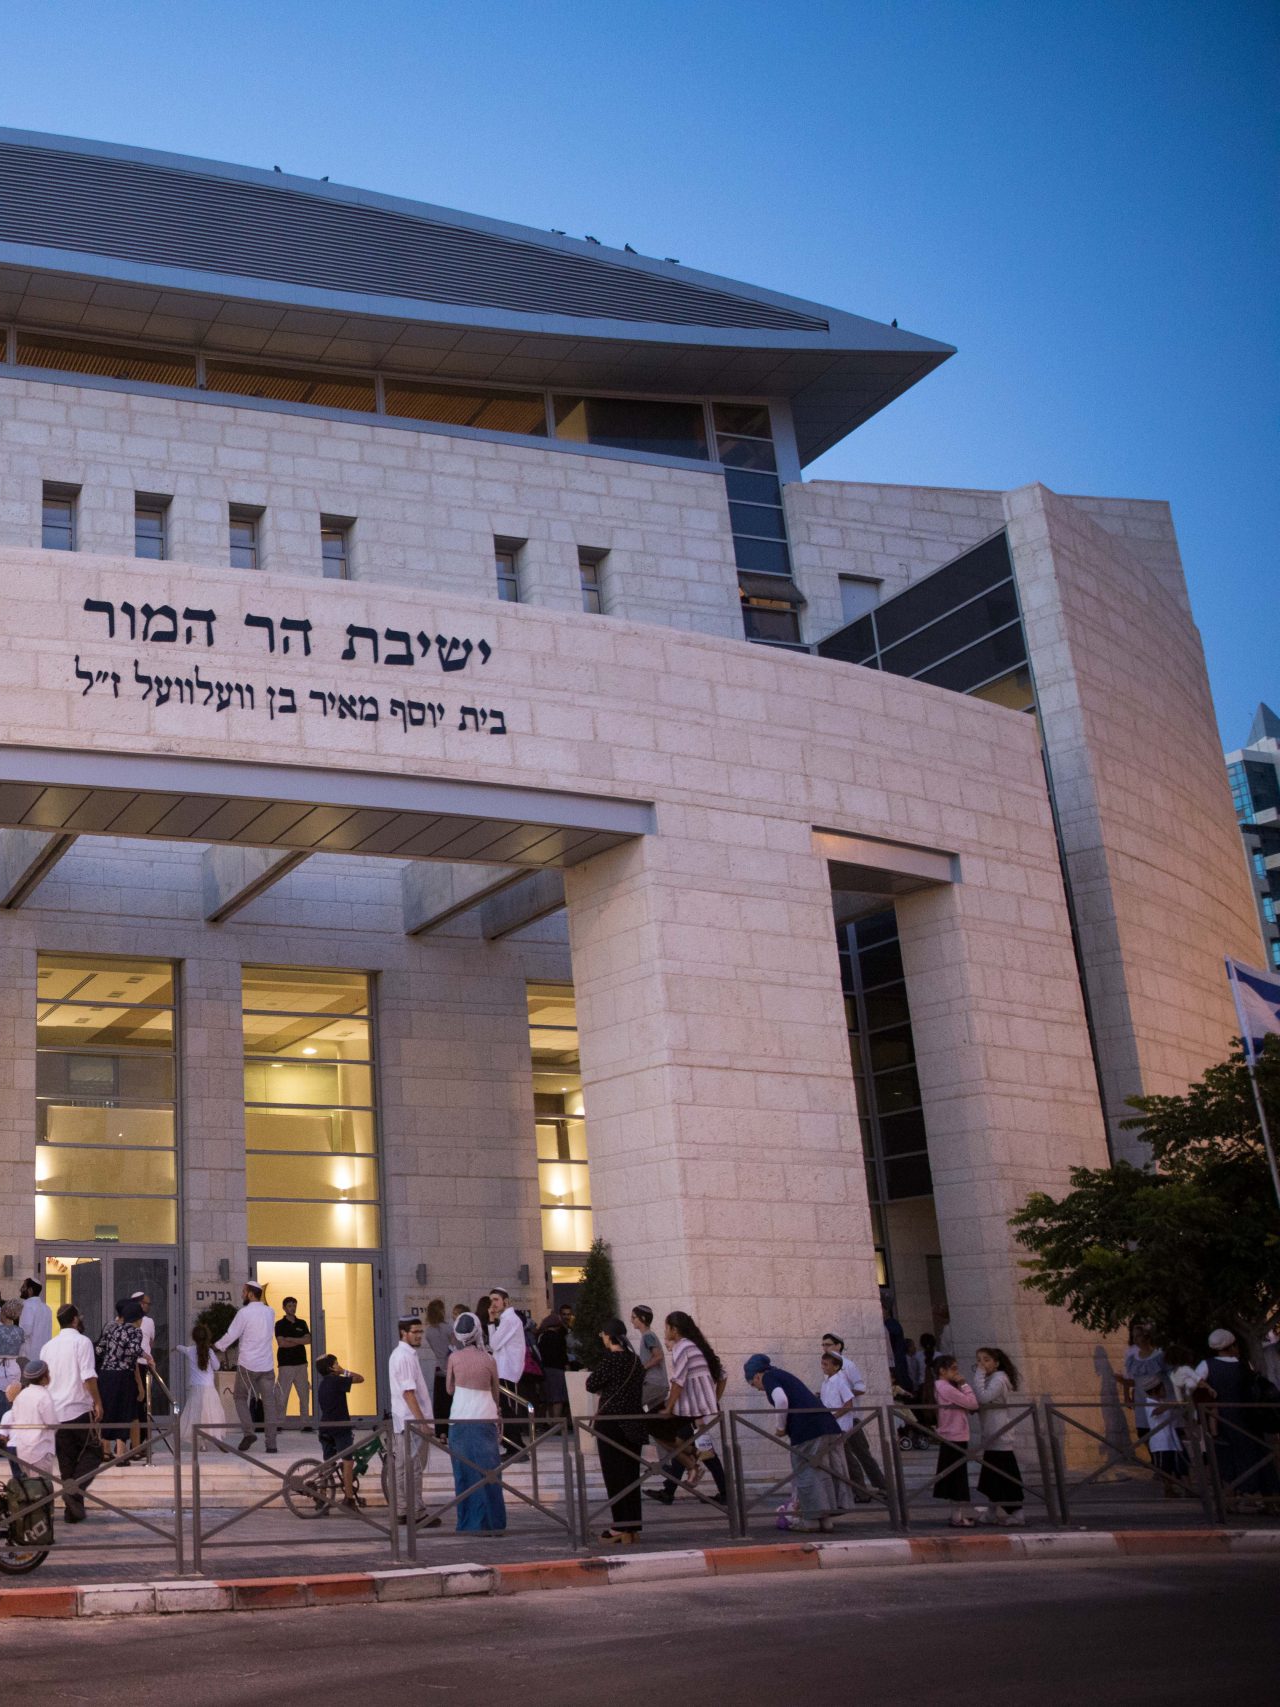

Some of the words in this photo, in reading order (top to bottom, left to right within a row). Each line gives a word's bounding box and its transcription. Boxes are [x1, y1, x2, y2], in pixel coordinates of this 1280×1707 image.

[83, 598, 217, 647] המור
[244, 613, 313, 657] הר
[341, 623, 492, 673] ישיבת
[133, 659, 255, 713] וועלוועל
[266, 686, 298, 721] בן
[308, 689, 380, 722] מאיר
[389, 698, 445, 734] יוסף
[458, 705, 508, 735] בית
[196, 1290, 232, 1301] גברים
